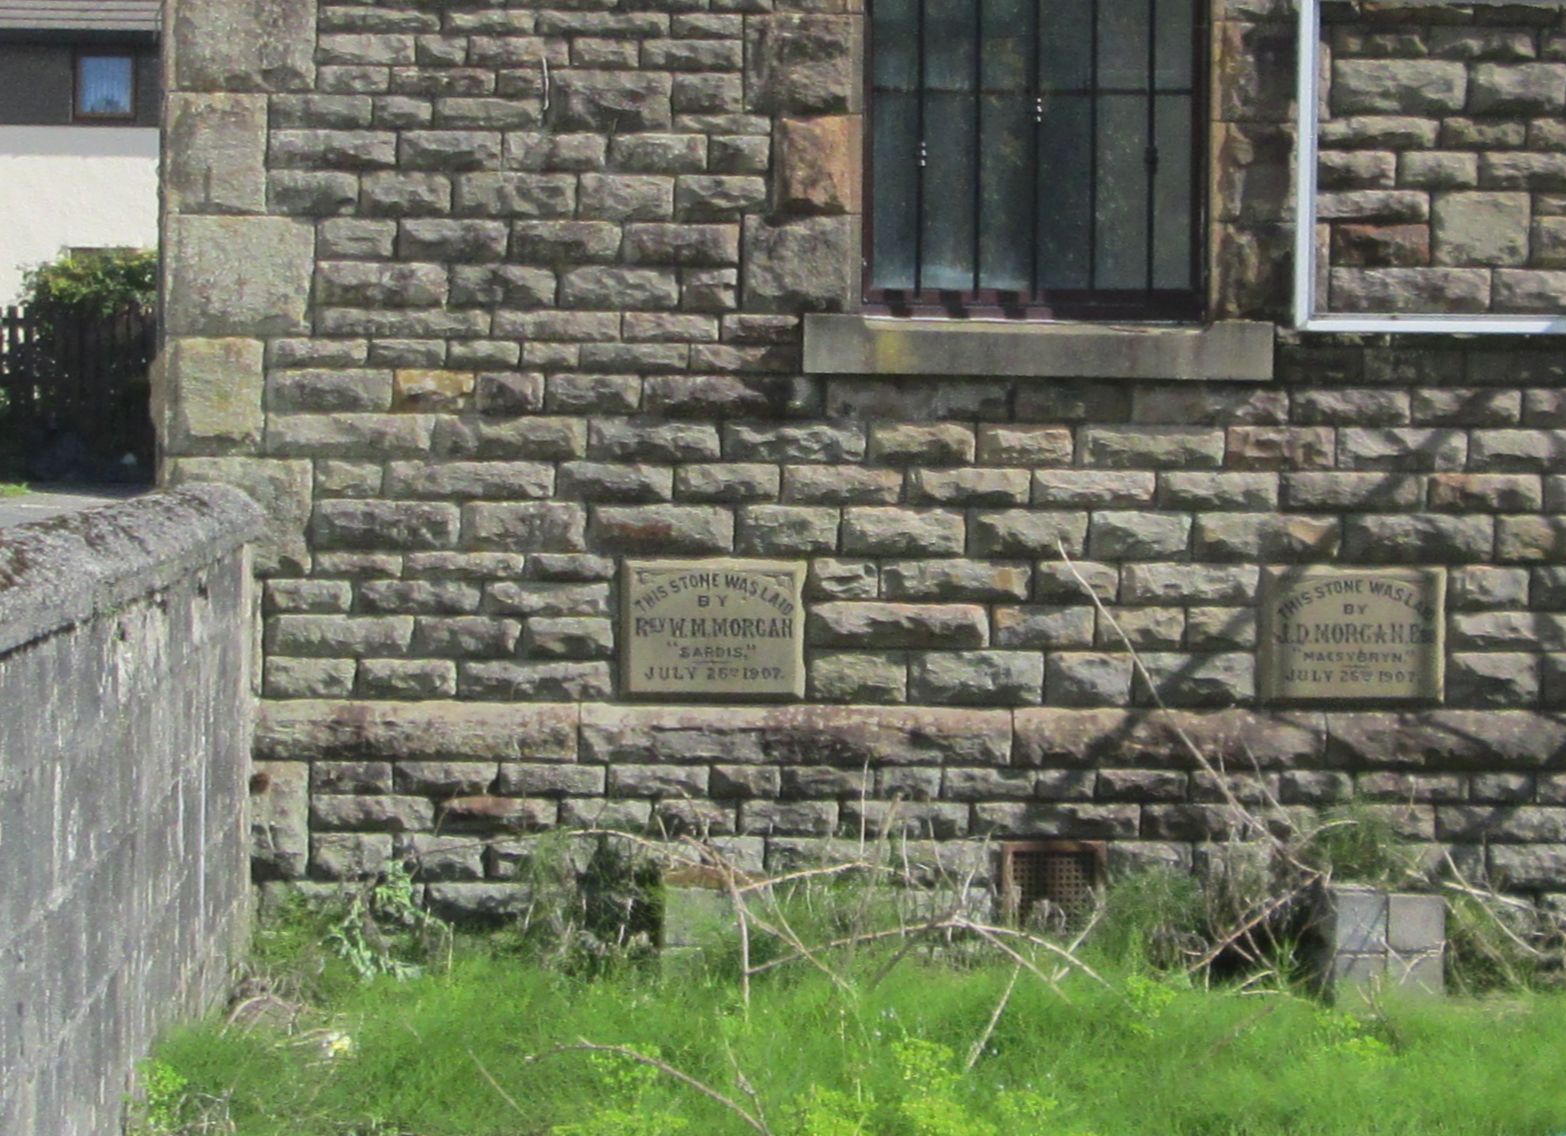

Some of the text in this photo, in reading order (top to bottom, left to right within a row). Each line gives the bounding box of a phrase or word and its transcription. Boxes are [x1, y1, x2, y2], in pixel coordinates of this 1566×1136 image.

[633, 573, 795, 615] THIS STONE WAS LAID
[1276, 591, 1313, 619] THIS
[1314, 580, 1364, 599] STONE
[1369, 581, 1403, 601] WAS
[697, 595, 728, 608] BY
[1343, 604, 1368, 615] BY
[644, 666, 697, 681] JULY
[1284, 669, 1333, 683] JULY
